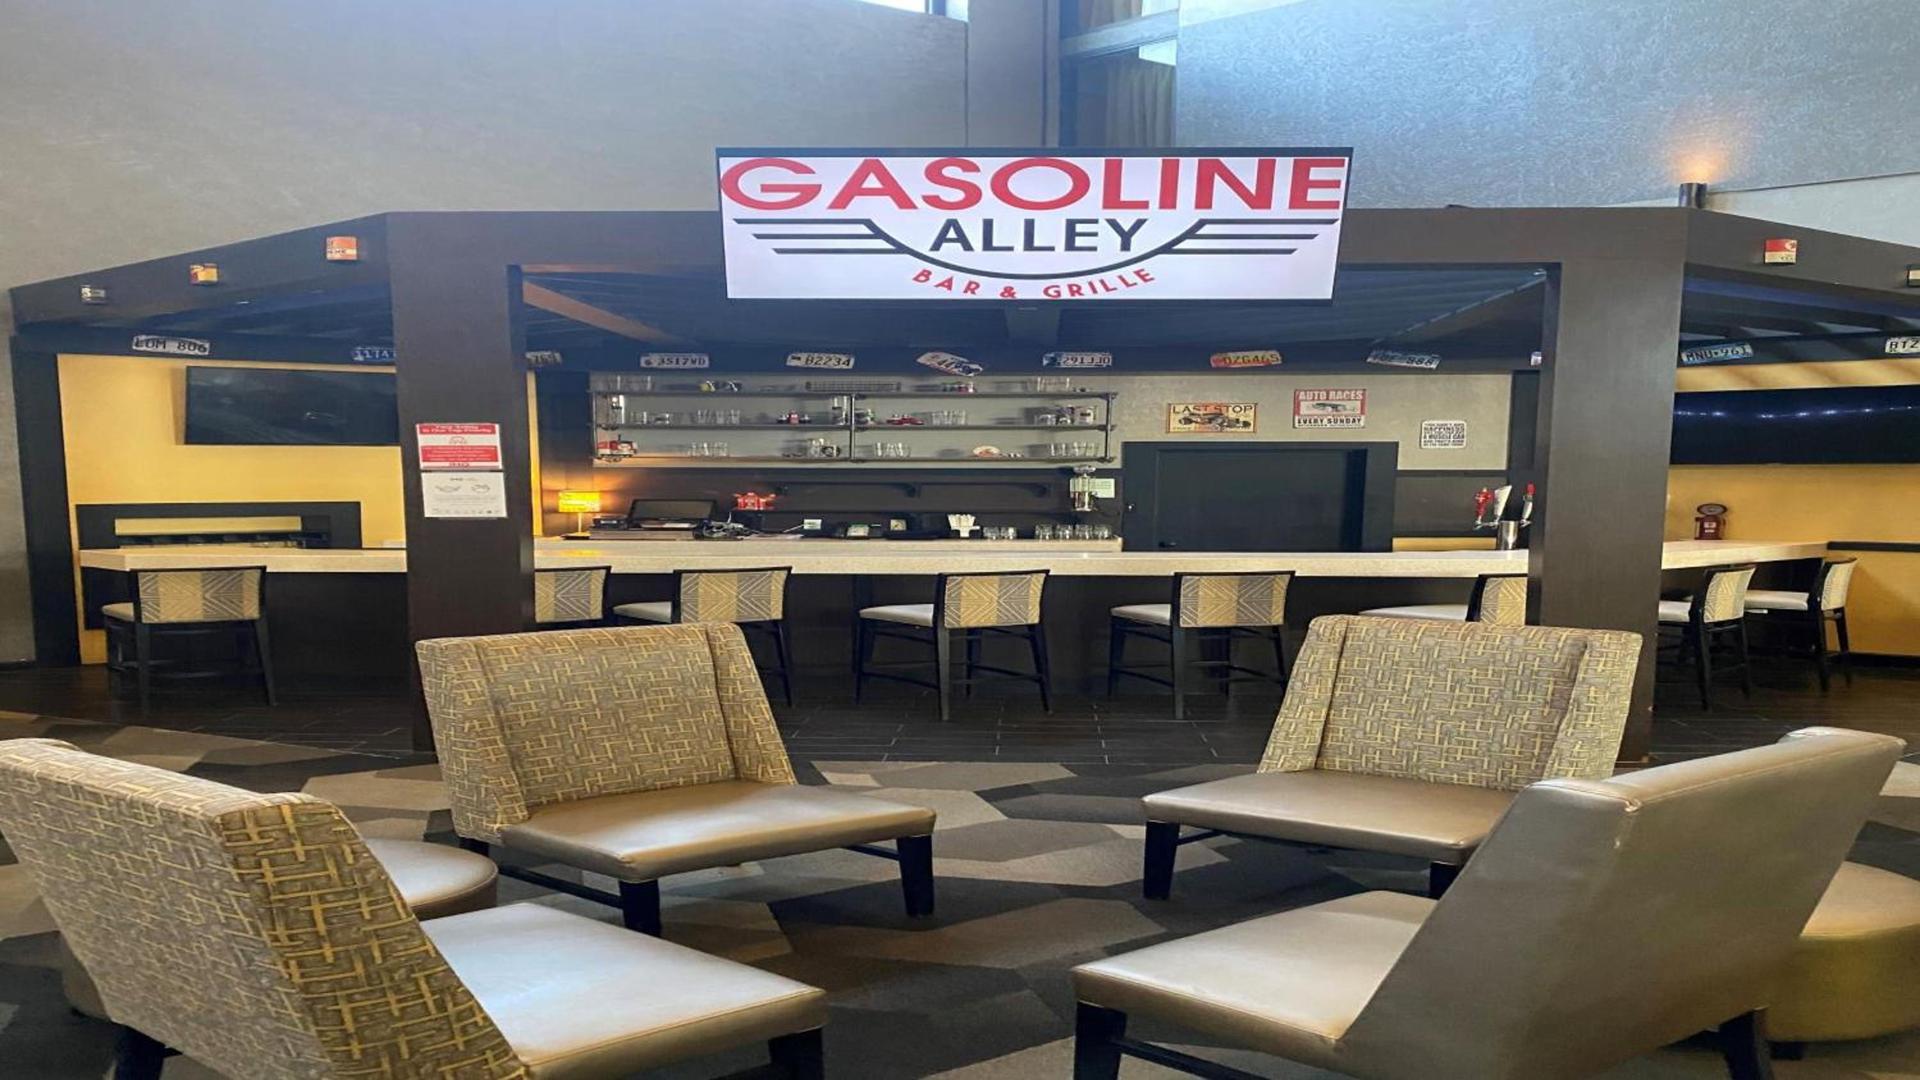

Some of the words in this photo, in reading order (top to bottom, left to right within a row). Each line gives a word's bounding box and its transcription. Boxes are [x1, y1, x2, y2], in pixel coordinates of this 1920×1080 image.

[720, 157, 1345, 210] GASOLINE
[929, 218, 1148, 252] ALLEY
[912, 268, 981, 295] BAR
[1000, 286, 1017, 298] &
[1043, 268, 1155, 298] GRILLE
[1172, 405, 1208, 414] LAST
[1214, 404, 1253, 414] STOP
[1299, 391, 1327, 400] AUTO
[1329, 391, 1363, 400] RACES
